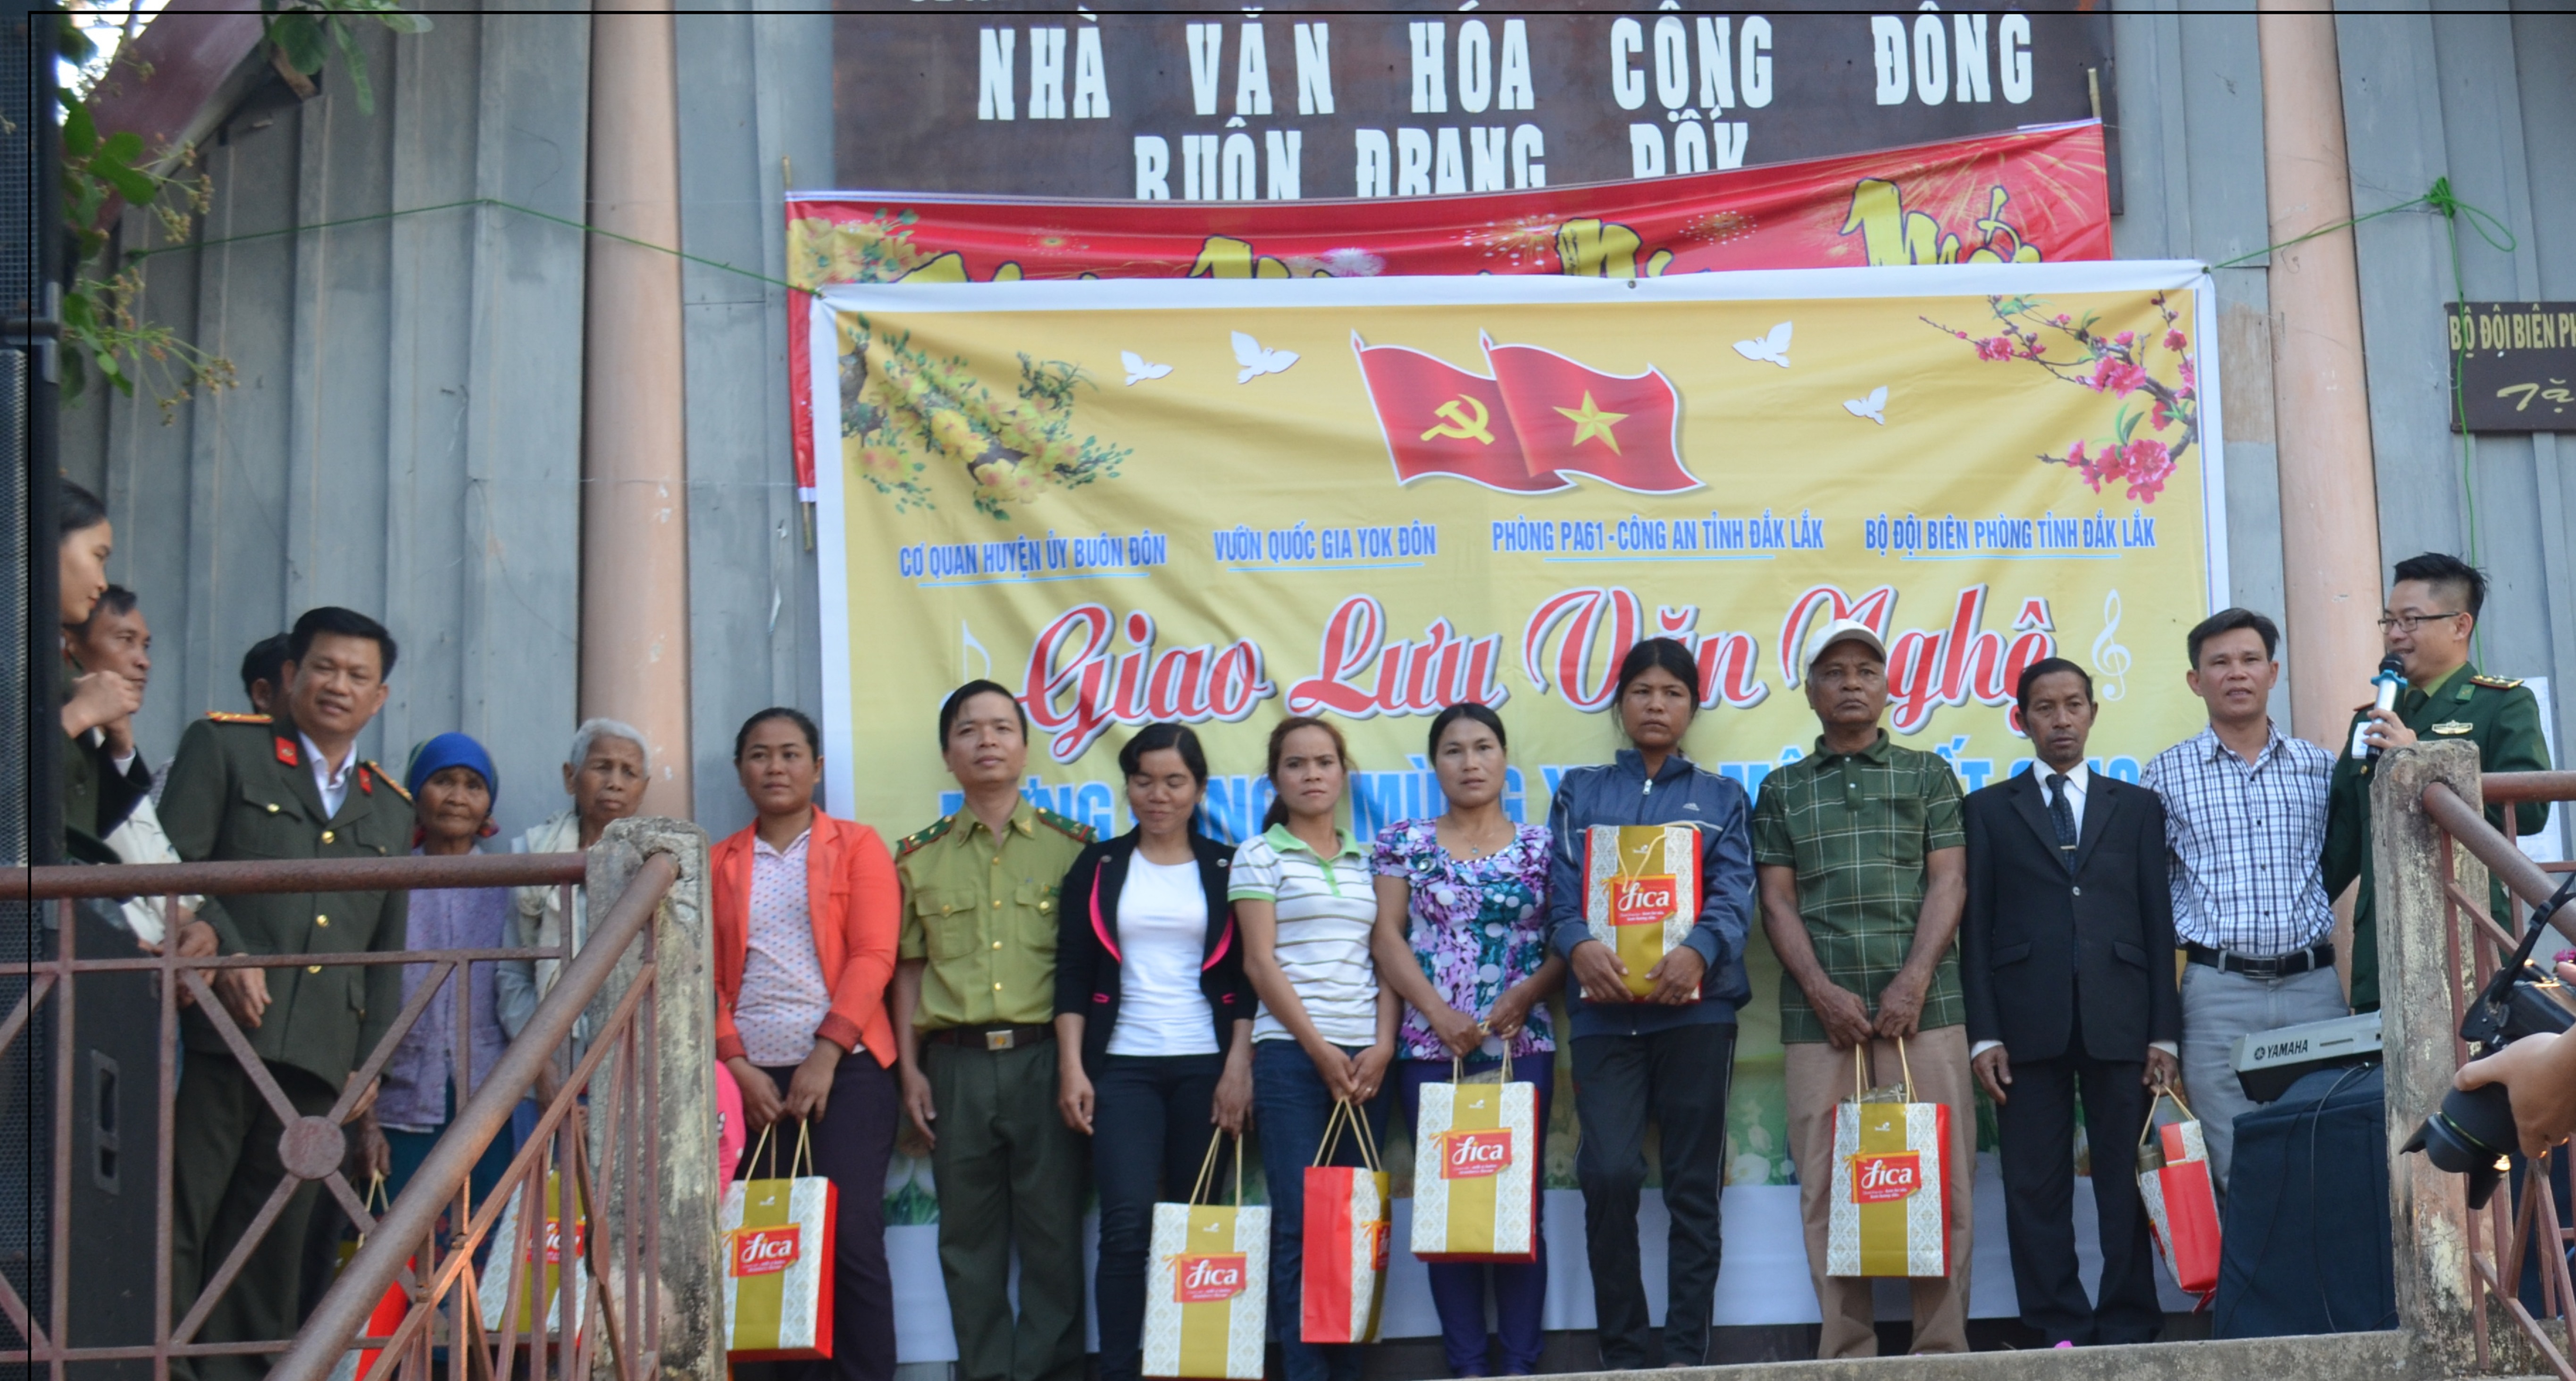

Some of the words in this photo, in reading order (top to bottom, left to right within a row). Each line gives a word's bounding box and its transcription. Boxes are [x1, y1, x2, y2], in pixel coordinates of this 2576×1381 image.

[979, 7, 1110, 120] NHÀ
[1187, 8, 1334, 115] VĂN
[1410, 0, 1534, 113] HÓA
[2449, 305, 2476, 358] BỘ
[2479, 304, 2511, 358] ĐỘI
[2513, 303, 2556, 349] BIÊN
[928, 544, 979, 579] QUAN
[982, 535, 1041, 579] HUYỆN
[1045, 530, 1069, 570] ỦY
[1073, 532, 1125, 568] BUÔN
[1128, 529, 1166, 567] ĐÔN
[1268, 520, 1316, 564] QUỐC
[1321, 529, 1354, 559] GIA
[1356, 527, 1393, 558] YOK
[1397, 519, 1437, 557] ĐÔN
[1492, 515, 1555, 551] PHÒNG
[1672, 520, 1698, 550] AN
[1701, 511, 1745, 549] TỈNH
[1748, 509, 1786, 549] ĐẮK
[1790, 509, 1824, 549] LẮK
[1865, 513, 1889, 556] BỘ
[1892, 514, 1923, 556] ĐỘI
[1927, 515, 1969, 550] BIÊN
[1974, 514, 2033, 549] PHÒNG
[2037, 511, 2078, 549] TỈNH
[2083, 509, 2118, 549] ĐẮK
[2122, 509, 2156, 548] LẮK
[1018, 603, 1277, 763] Giao
[1285, 593, 1510, 720] Lưu
[2267, 1039, 2308, 1059] YAMAHA
